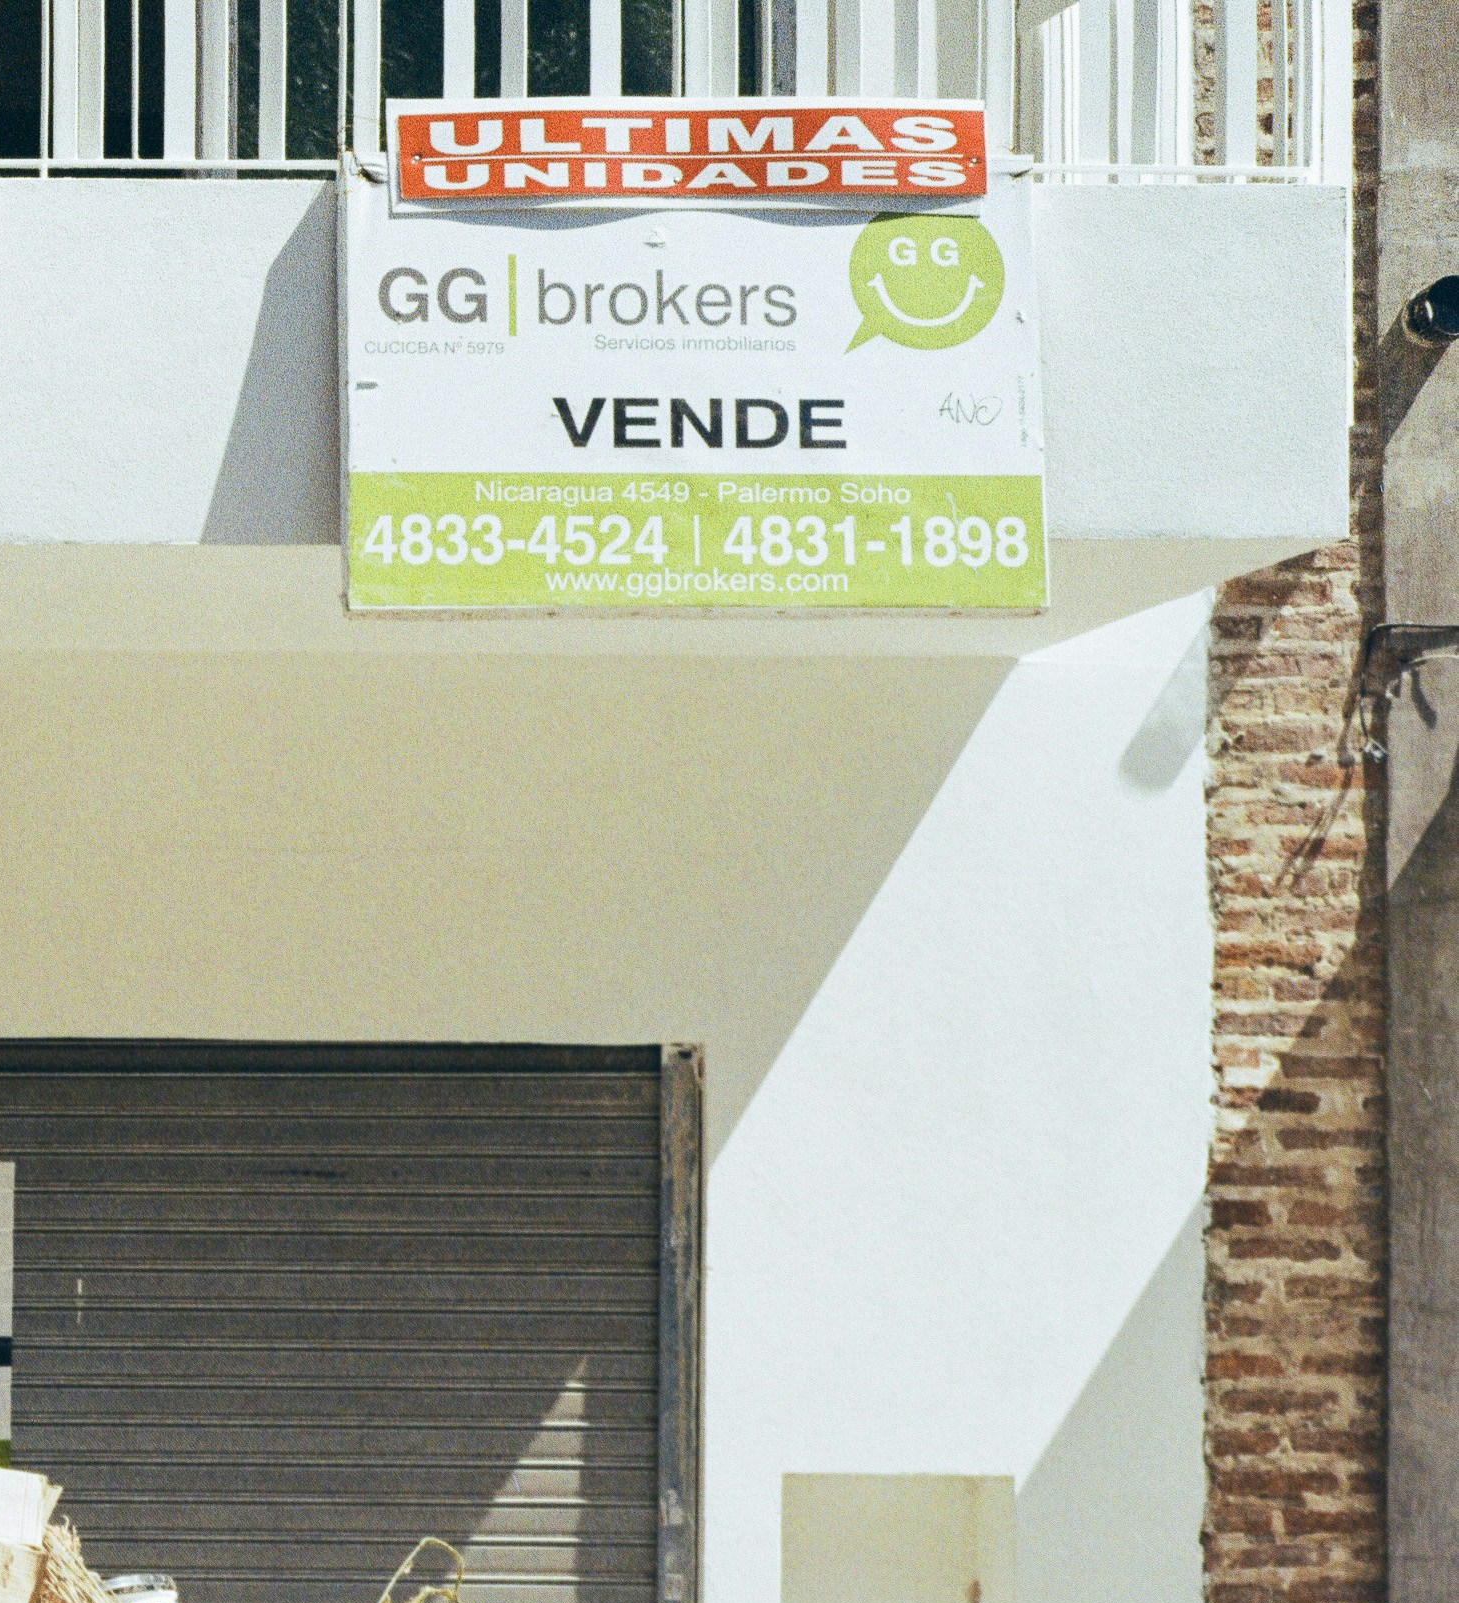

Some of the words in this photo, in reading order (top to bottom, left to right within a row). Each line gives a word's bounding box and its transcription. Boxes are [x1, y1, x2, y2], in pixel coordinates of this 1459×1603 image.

[427, 116, 960, 156] ULTIMAS
[422, 159, 968, 191] UNIDADES
[377, 266, 490, 325] GG
[537, 268, 799, 328] brokers
[364, 340, 440, 355] CUCICBA
[466, 340, 505, 355] 5979
[594, 334, 676, 352] Servicios
[682, 335, 798, 353] inmobiliarios
[552, 396, 848, 450] VENDE
[474, 481, 615, 506] Nicaragua
[620, 481, 690, 503] 4549
[717, 481, 828, 505] Palermo
[840, 481, 912, 505] Soho
[363, 514, 669, 566] 4833-4524
[722, 514, 1030, 568] 4831-1898
[544, 567, 849, 596] www.ggbrokers.com
